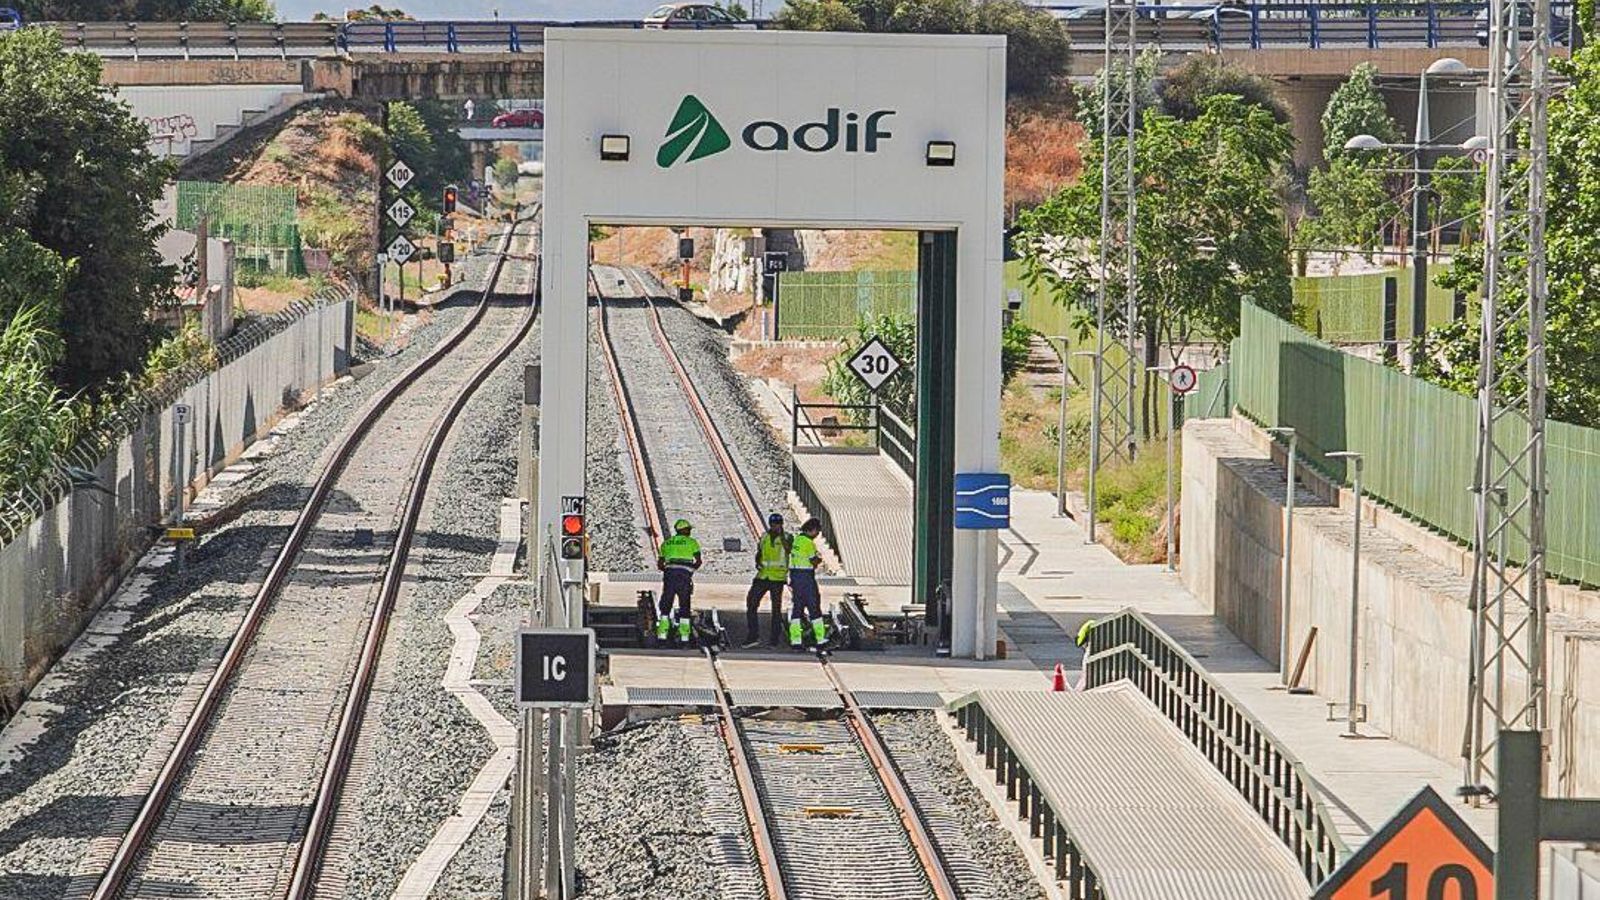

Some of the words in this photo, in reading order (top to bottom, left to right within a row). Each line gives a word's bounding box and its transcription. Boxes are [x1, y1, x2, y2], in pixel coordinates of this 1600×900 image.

[741, 108, 897, 153] adif
[391, 168, 409, 181] 100
[391, 206, 410, 219] 115
[861, 354, 889, 375] 30
[543, 655, 567, 681] IC
